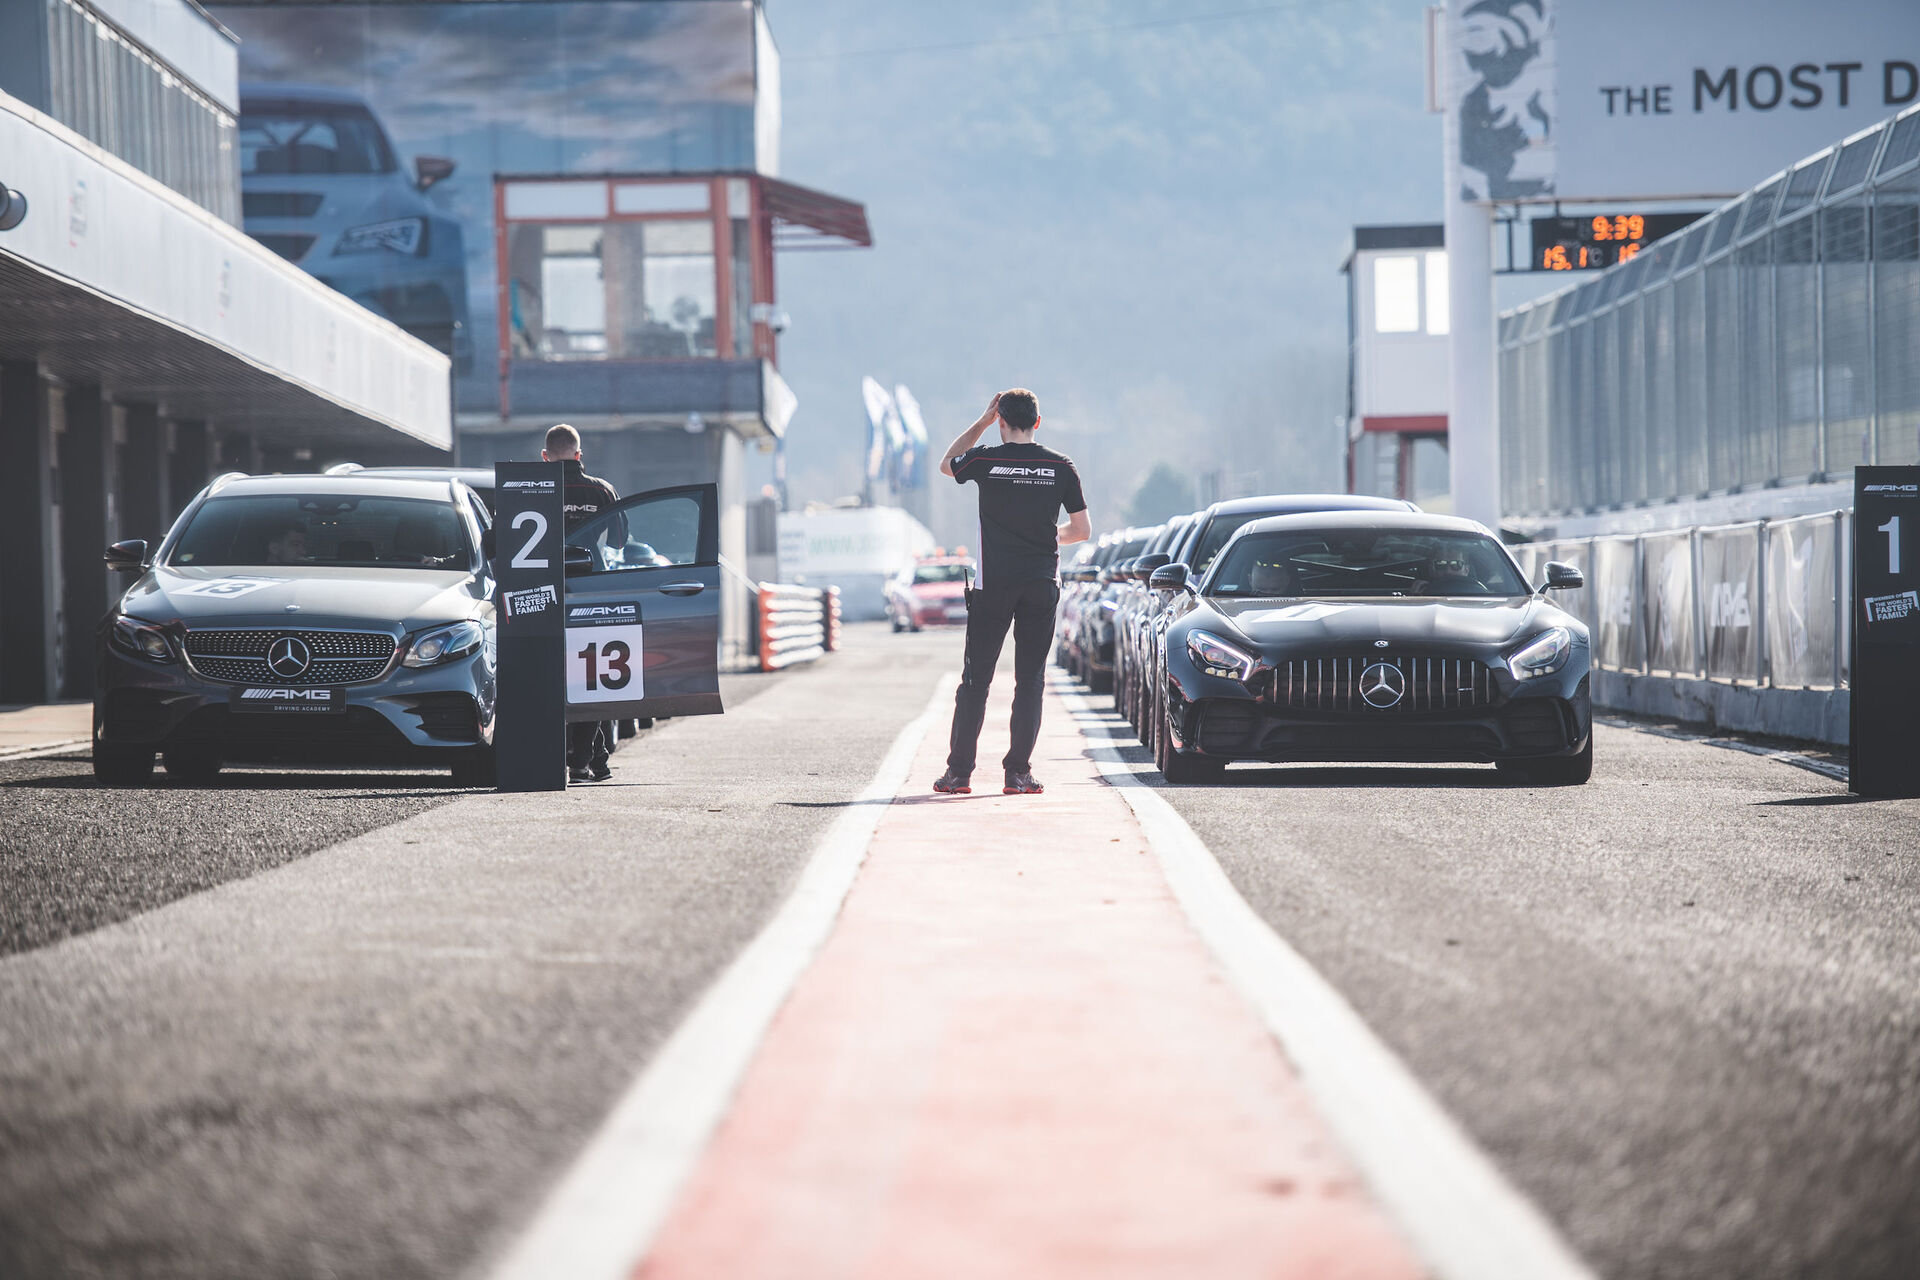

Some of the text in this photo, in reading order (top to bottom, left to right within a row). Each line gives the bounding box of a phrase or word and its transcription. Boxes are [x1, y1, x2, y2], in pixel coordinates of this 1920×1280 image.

[1600, 86, 1672, 116] THE
[1693, 62, 1862, 112] MOST
[1592, 214, 1644, 241] 9:39
[1009, 467, 1055, 477] AMG
[518, 480, 555, 488] AMG
[1879, 484, 1918, 492] AMG
[511, 510, 549, 568] 2
[1878, 516, 1900, 573] 1
[193, 582, 257, 594] 13
[515, 596, 551, 609] FASTEST
[1876, 602, 1913, 614] FASTEST
[515, 603, 546, 615] FAMILY
[590, 605, 636, 616] AMG
[1877, 610, 1908, 622] FAMILY
[578, 640, 631, 691] 13
[267, 689, 331, 700] AMG
